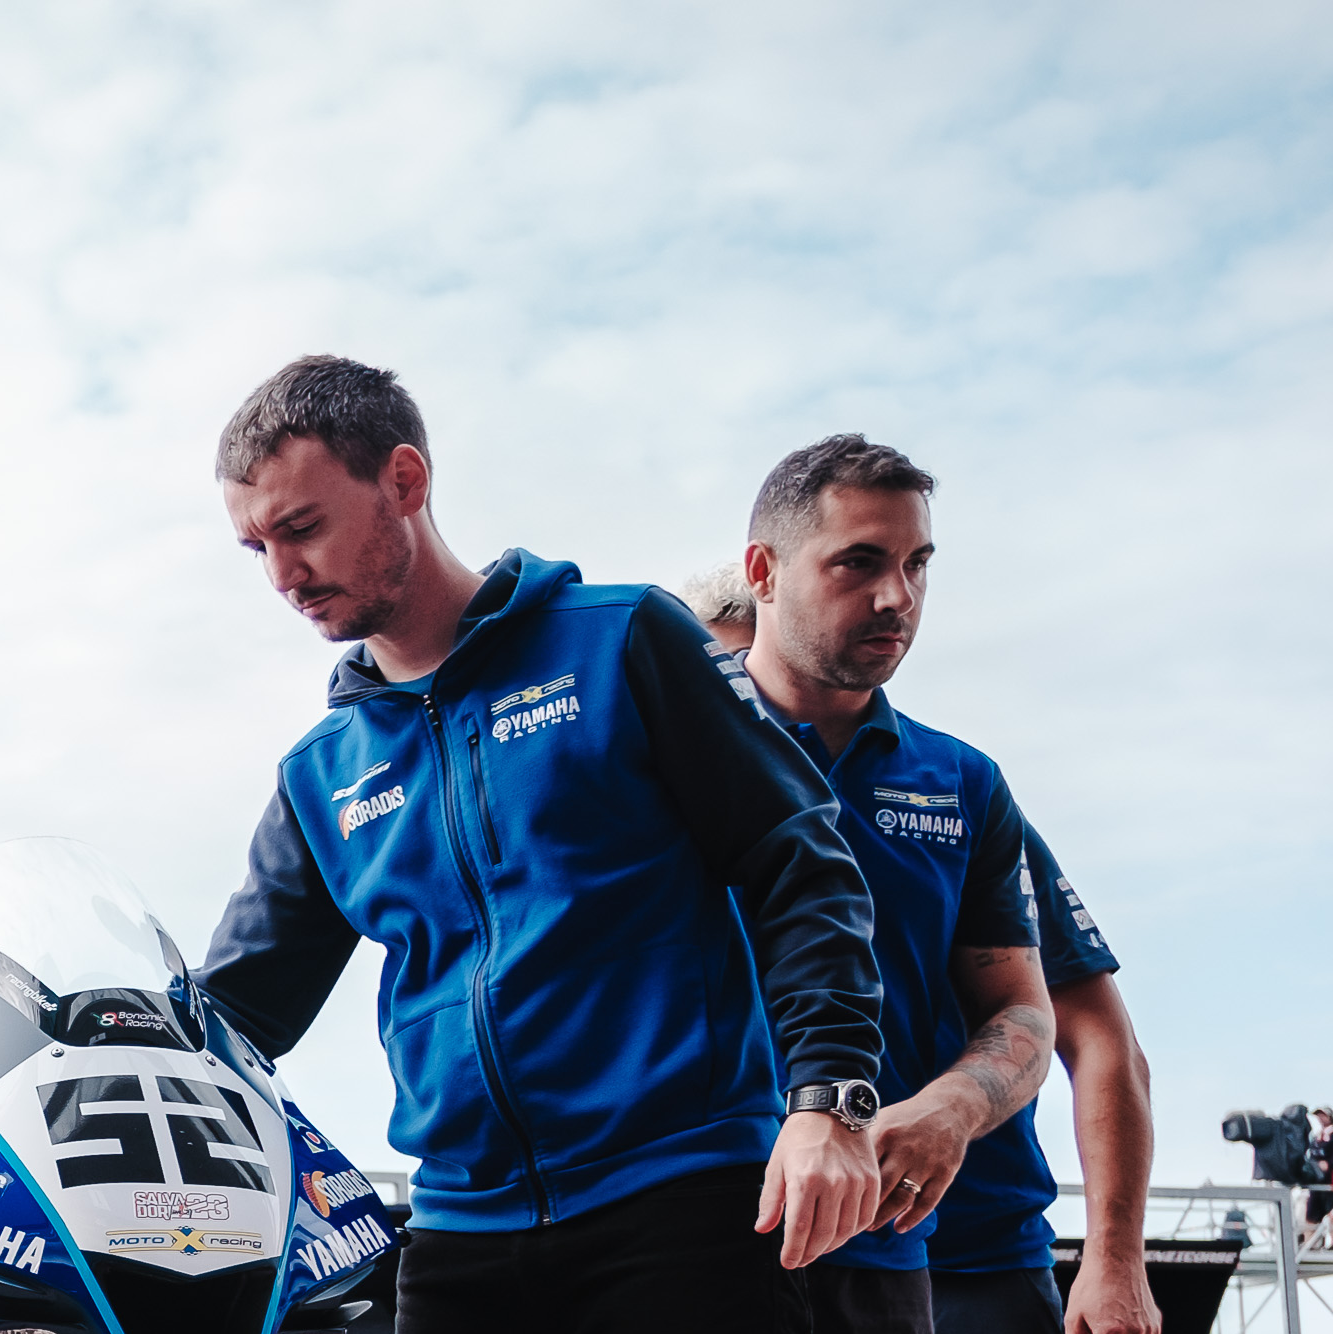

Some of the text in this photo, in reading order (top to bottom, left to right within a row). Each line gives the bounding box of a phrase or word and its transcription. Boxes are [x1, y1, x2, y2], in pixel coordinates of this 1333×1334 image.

[511, 696, 581, 731] YAMAHA
[499, 714, 577, 744] RACING
[883, 828, 957, 845] RACING
[897, 811, 963, 837] YAMAHA
[124, 1018, 163, 1031] Racing
[36, 1074, 277, 1197] 52
[109, 1236, 165, 1247] MOTO
[209, 1237, 263, 1249] racing
[296, 1213, 392, 1281] YAMAHA
